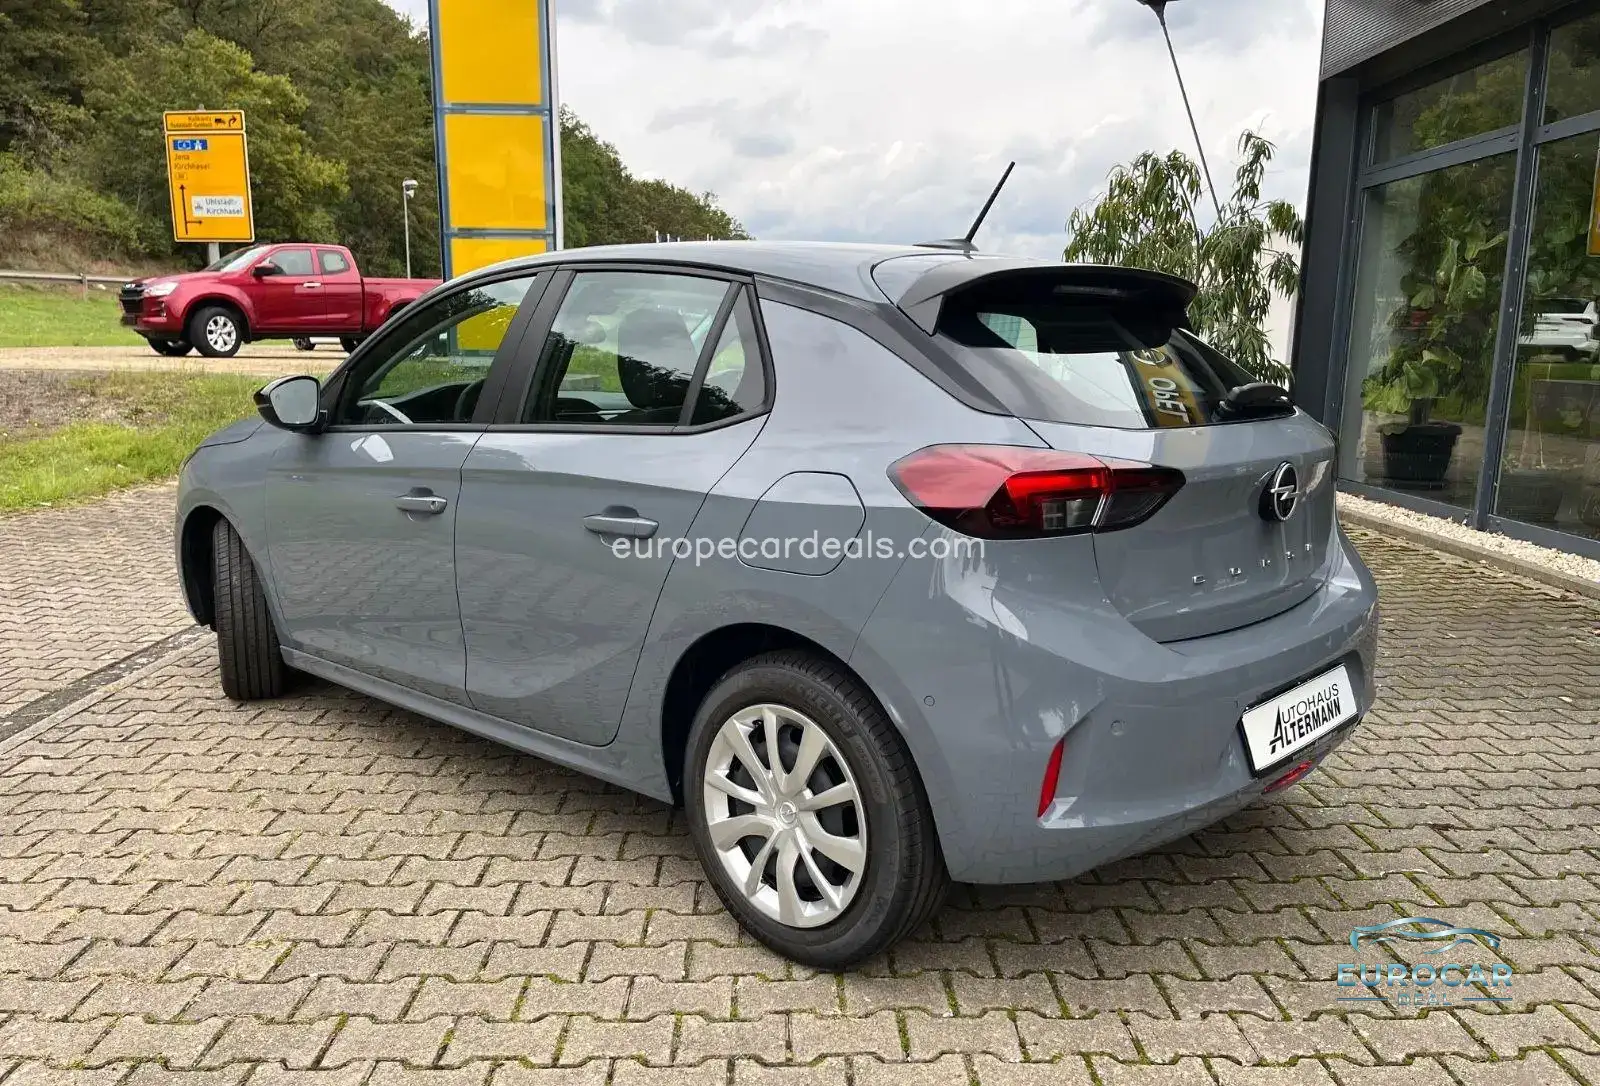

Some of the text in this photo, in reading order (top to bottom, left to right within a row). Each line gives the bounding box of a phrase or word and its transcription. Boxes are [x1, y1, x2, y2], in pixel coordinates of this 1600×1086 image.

[174, 153, 190, 161] Jena
[206, 207, 243, 215] Kirchhasel
[1269, 683, 1339, 746] AUTOHAUS
[1269, 697, 1341, 754] ALTERMANN
